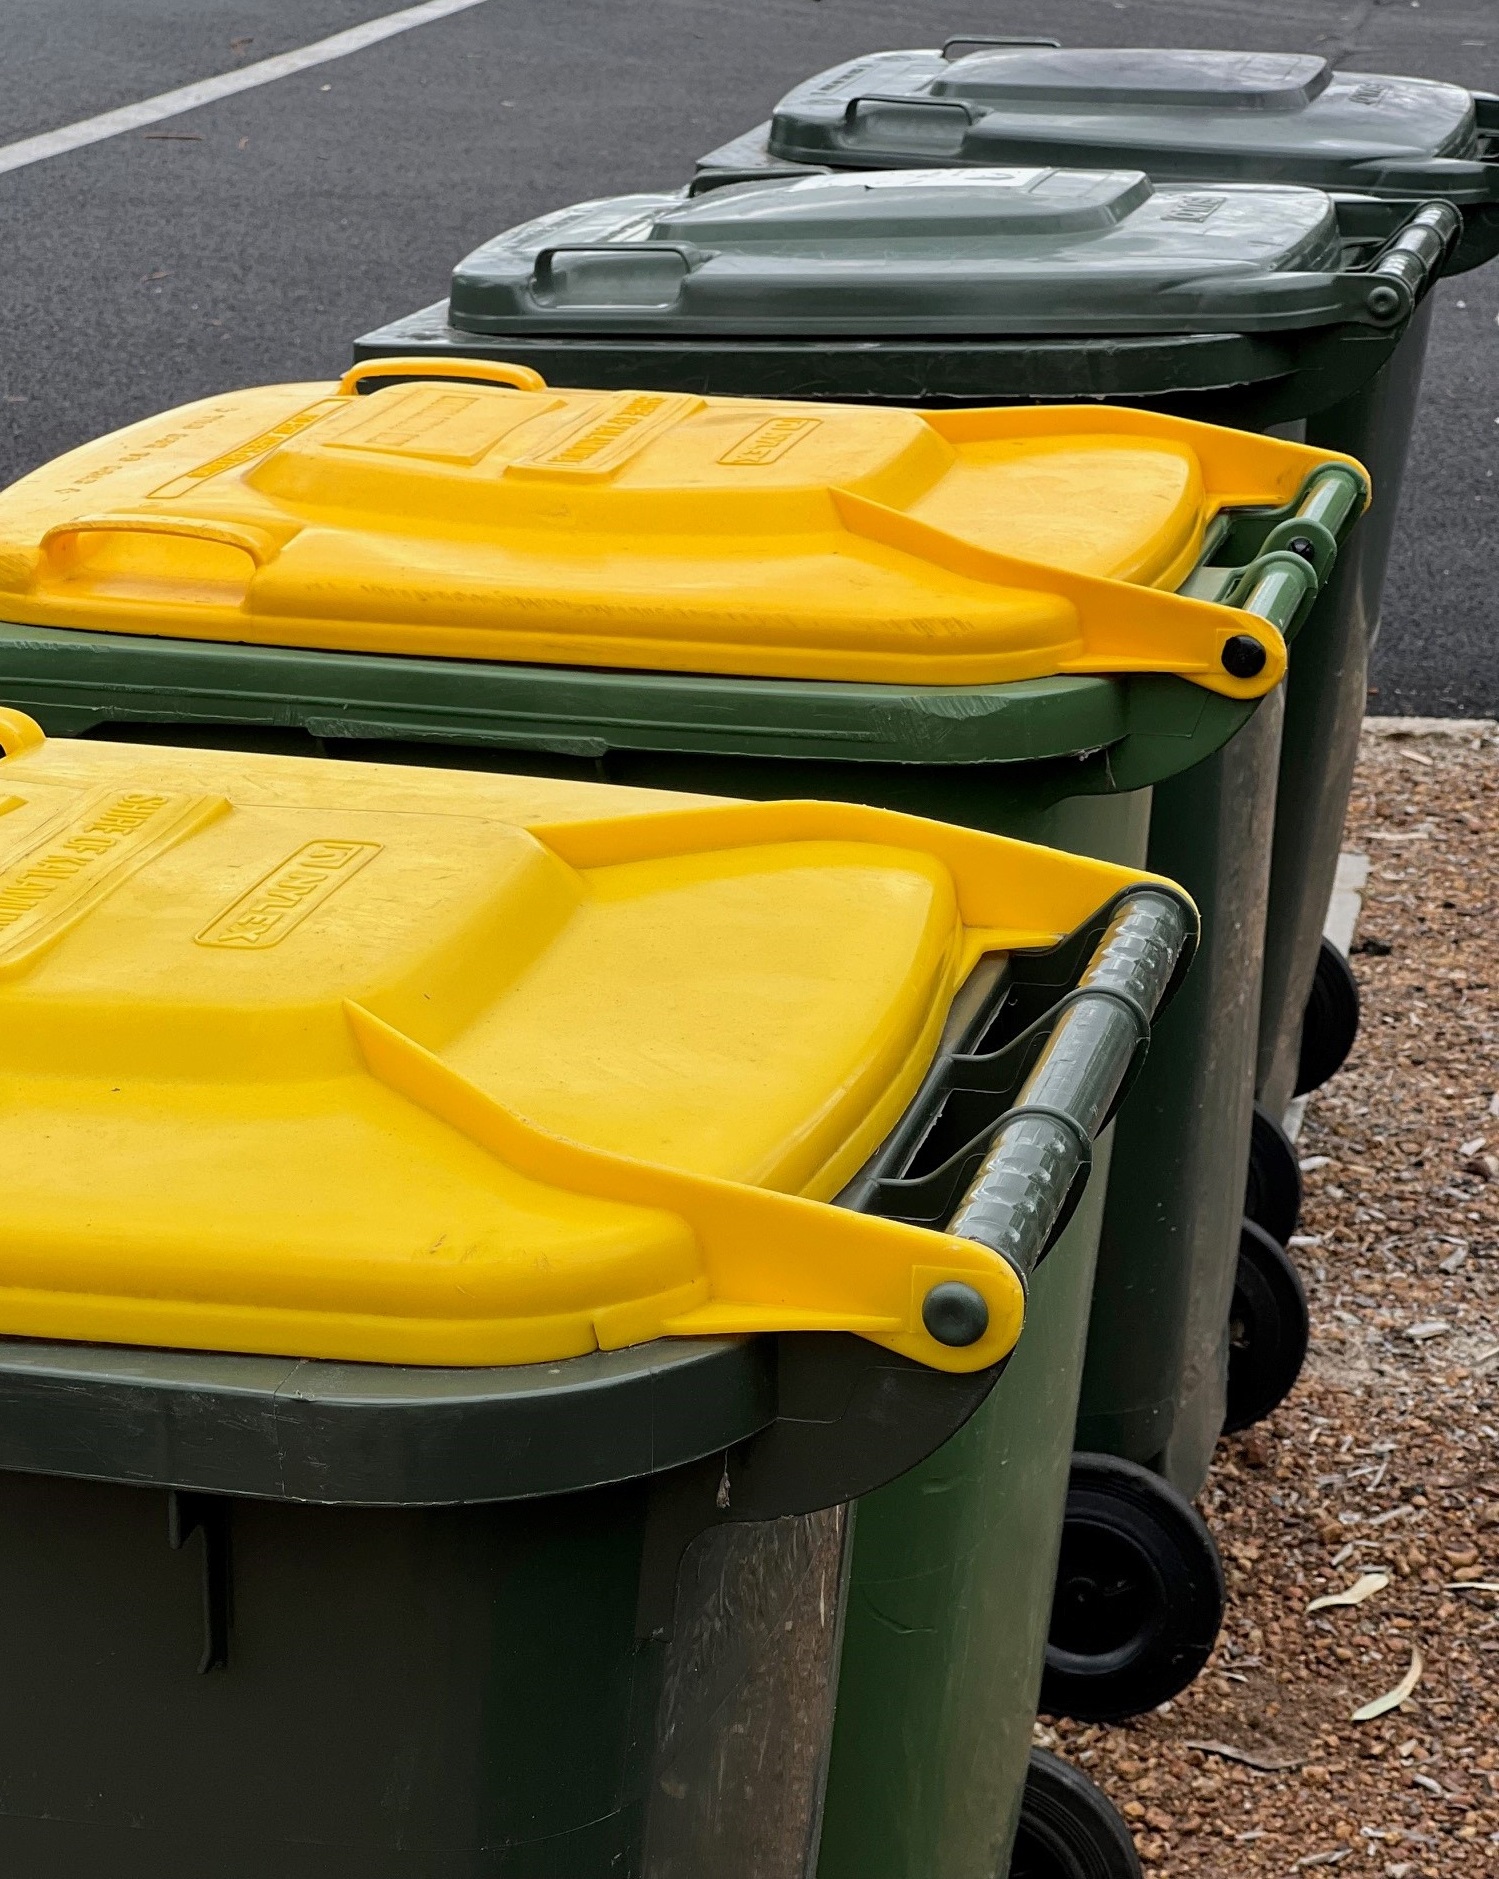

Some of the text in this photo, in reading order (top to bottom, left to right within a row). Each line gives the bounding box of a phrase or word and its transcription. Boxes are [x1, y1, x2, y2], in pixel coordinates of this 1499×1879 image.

[83, 793, 169, 836] SHIRE
[62, 836, 117, 855] OF
[218, 871, 329, 944] NYLEX
